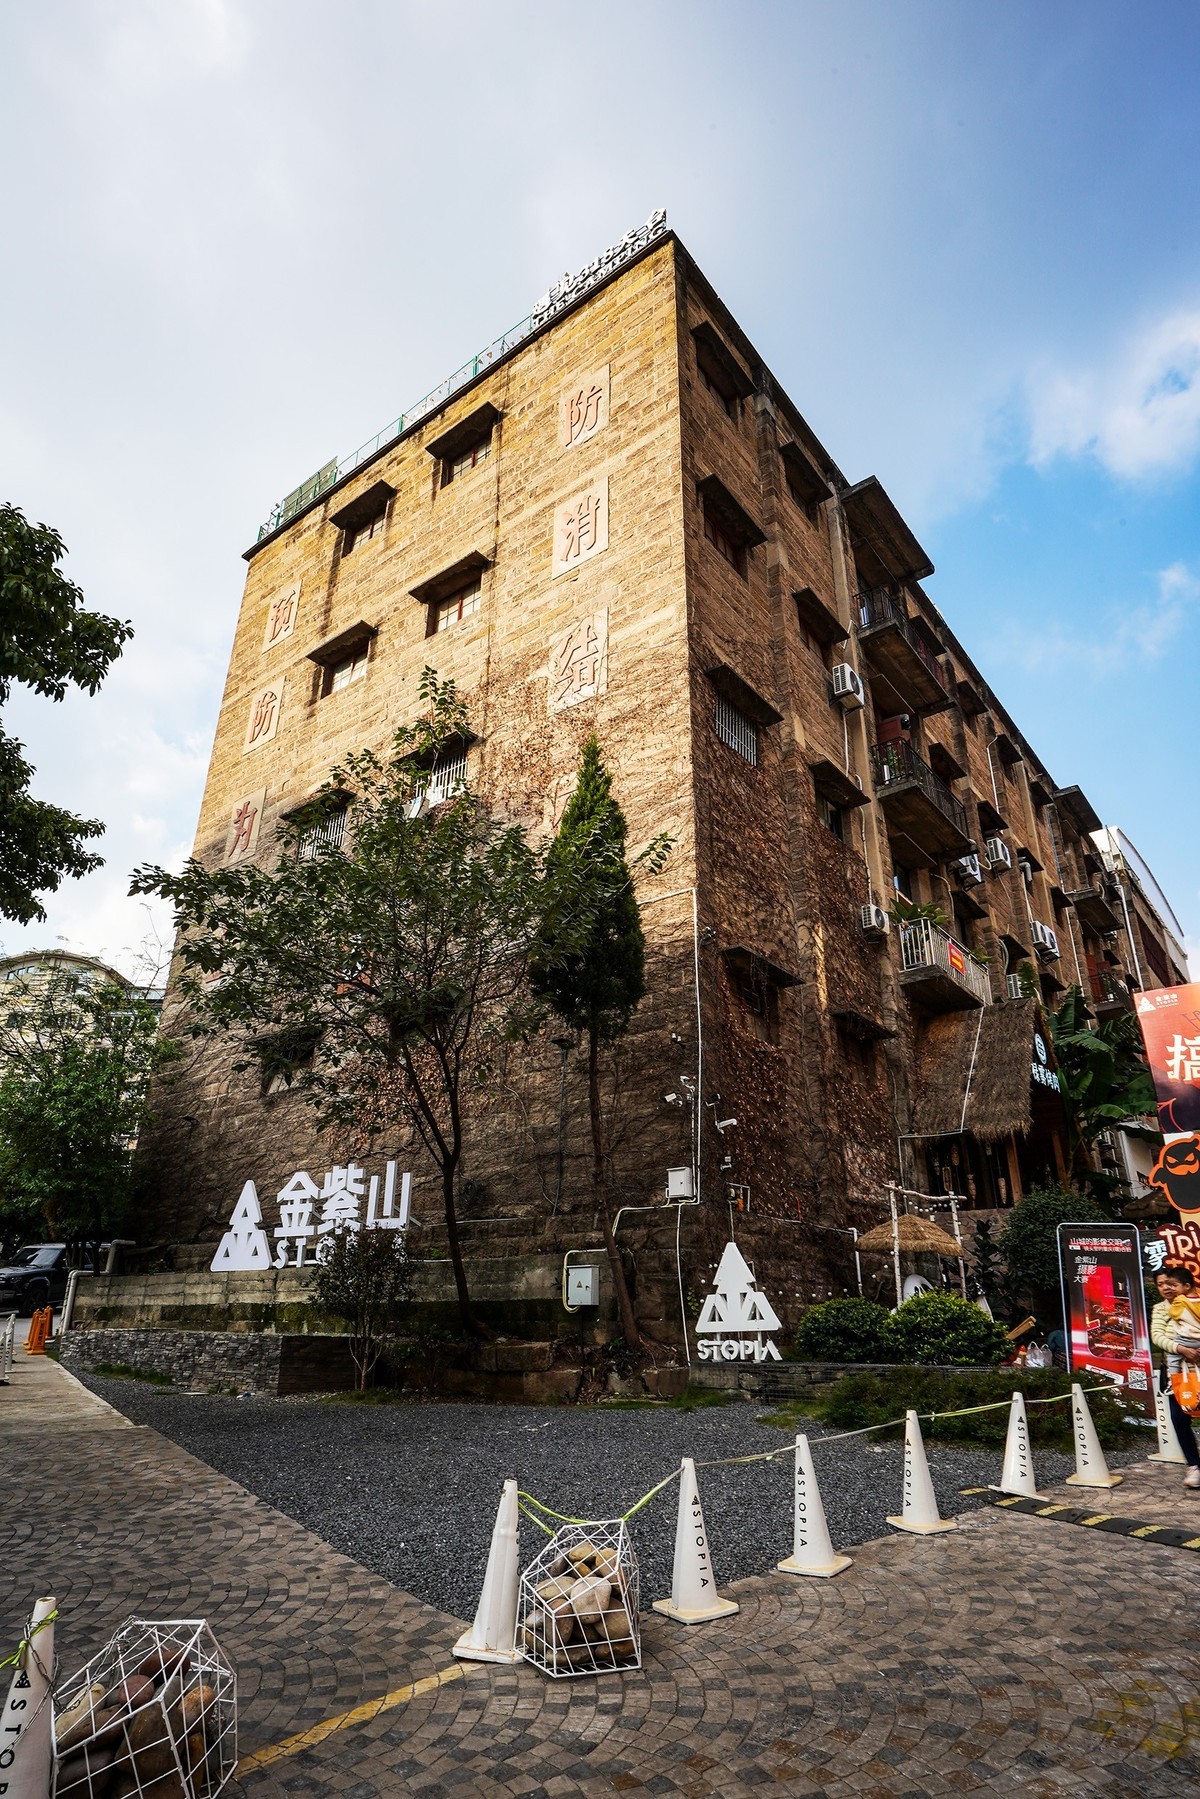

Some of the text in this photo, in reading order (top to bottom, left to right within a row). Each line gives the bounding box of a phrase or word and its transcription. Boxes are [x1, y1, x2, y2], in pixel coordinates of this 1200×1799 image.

[533, 225, 667, 328] THE CAMPING
[274, 1160, 411, 1238] 金紫山
[697, 1339, 783, 1361] STOPIA
[1018, 1426, 1028, 1479] STOPIA
[1075, 1416, 1090, 1467] STOPIA
[1157, 1400, 1169, 1445] STOPIA
[796, 1480, 808, 1547] STOPIA
[692, 1510, 709, 1588] STOPIA
